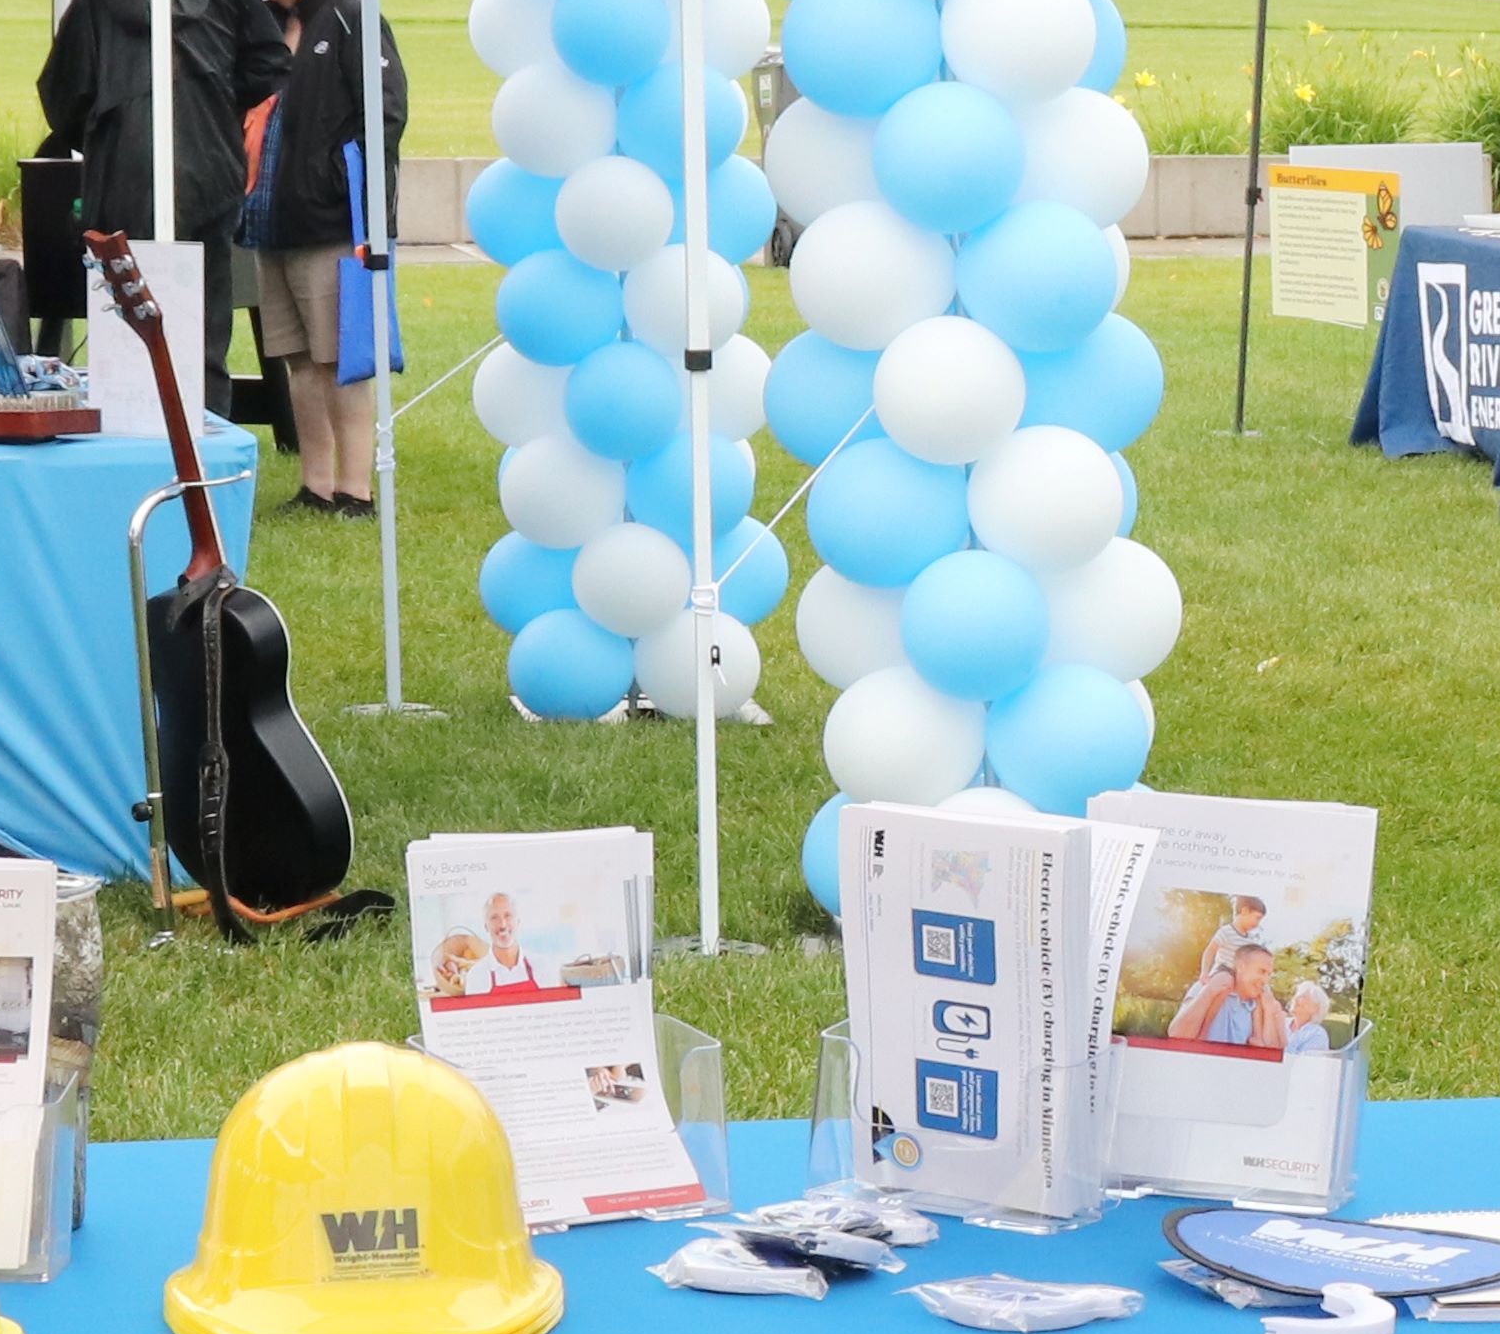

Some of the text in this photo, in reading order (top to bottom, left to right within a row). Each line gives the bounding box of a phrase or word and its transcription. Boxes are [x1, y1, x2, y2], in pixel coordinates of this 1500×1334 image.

[1276, 172, 1327, 187] Butterflies
[1172, 839, 1219, 857] nothing
[1222, 846, 1235, 856] to
[1238, 847, 1283, 862] chance
[1179, 828, 1191, 837] or
[1195, 831, 1227, 843] away
[422, 861, 488, 876] My Business
[1116, 842, 1145, 900] Electric
[1100, 904, 1125, 960] vehicle
[1094, 962, 1110, 994] (EV)
[1040, 851, 1055, 1189] Electric vehicle (EV) charging in Minnesota
[321, 1208, 419, 1254] WH
